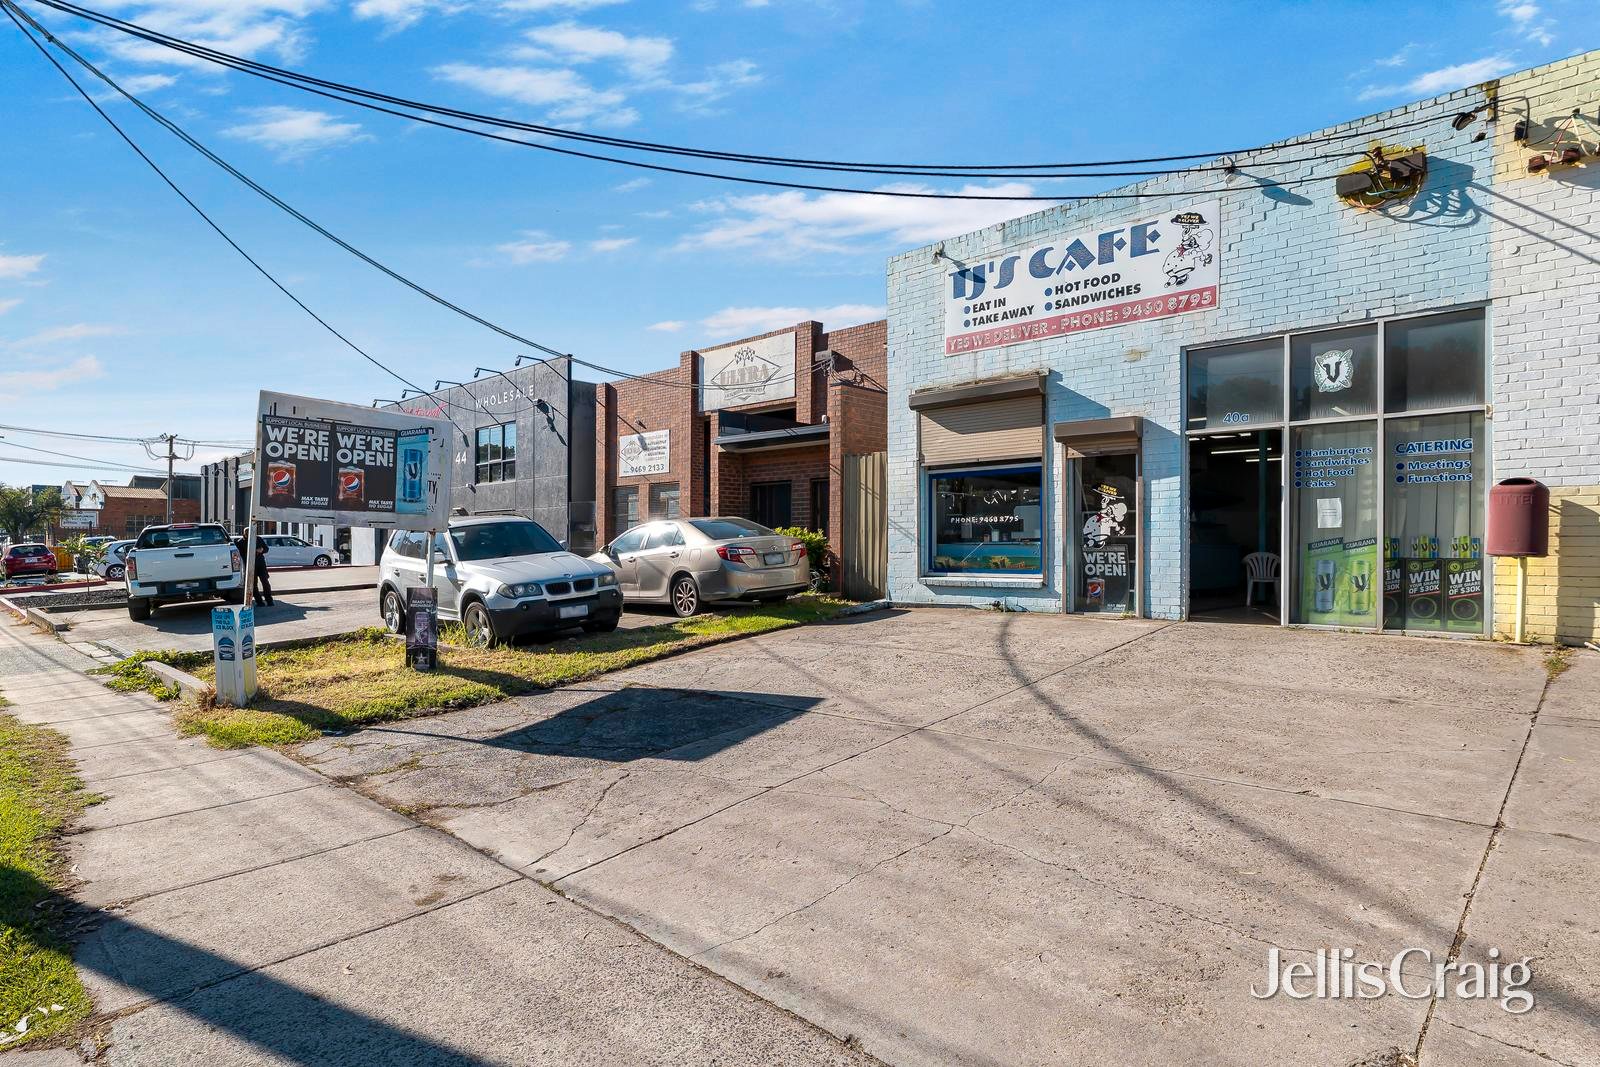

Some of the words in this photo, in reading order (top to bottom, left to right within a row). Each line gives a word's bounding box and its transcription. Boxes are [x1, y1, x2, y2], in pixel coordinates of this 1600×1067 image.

[1028, 219, 1162, 279] CAFE
[1054, 281, 1080, 296] HOT
[1083, 272, 1122, 290] FOOD
[1054, 283, 1142, 310] SANDWICHES
[972, 301, 992, 314] EAT
[994, 298, 1007, 311] IN
[950, 338, 970, 351] YES
[972, 333, 991, 347] WE
[994, 322, 1049, 343] DELIVER
[1060, 308, 1119, 331] PHONE:
[1167, 291, 1212, 310] 8795
[972, 313, 1000, 328] TAKE
[1001, 304, 1035, 321] AWAY
[475, 385, 534, 409] WHOLESALE
[1222, 412, 1250, 424] 40a
[266, 425, 330, 446] WE'RE
[400, 428, 427, 436] GUARANA
[336, 432, 394, 452] WE'RE
[1396, 438, 1473, 454] CATERING
[266, 442, 329, 462] OPEN!
[336, 448, 394, 468] OPEN!
[455, 451, 467, 465] 44
[1304, 447, 1372, 458] Hamburgers
[648, 464, 664, 472] 2133
[1304, 457, 1370, 468] Sandwiches
[1408, 459, 1472, 471] Meetings
[1304, 469, 1324, 478] Hot
[1327, 466, 1354, 476] Food
[1408, 472, 1472, 484] Functions
[1304, 479, 1336, 488] Cakes
[950, 516, 978, 524] PHONE:
[1312, 539, 1340, 549] GUARANA
[1346, 538, 1376, 549] GUARANA
[1083, 552, 1126, 564] WE'RE
[1084, 564, 1126, 576] OPEN!
[1409, 569, 1440, 584] WIN
[1449, 570, 1481, 585] WIN
[1420, 584, 1440, 593] $30K
[1448, 588, 1459, 596] OF
[1461, 586, 1480, 594] $30K
